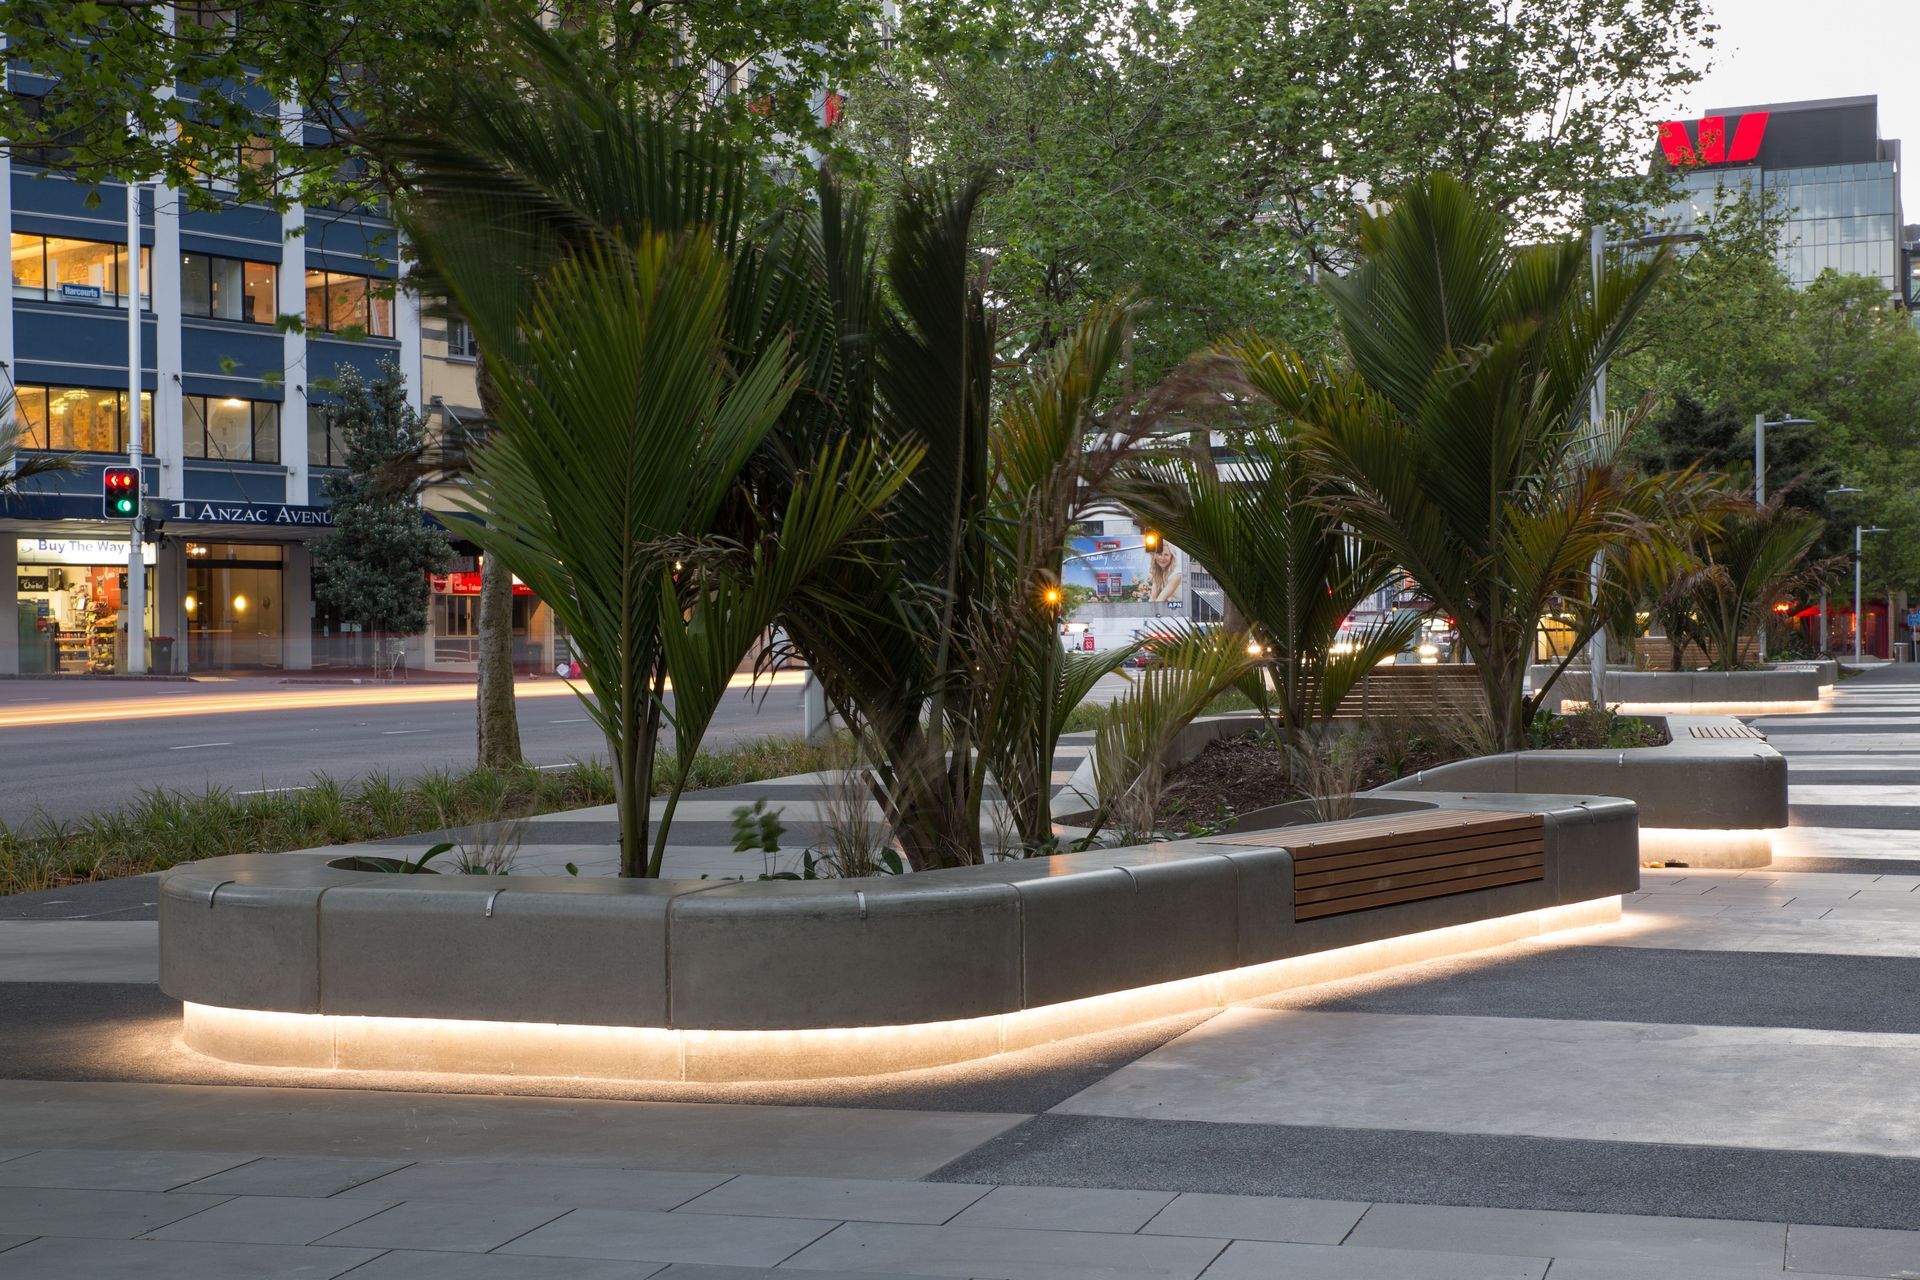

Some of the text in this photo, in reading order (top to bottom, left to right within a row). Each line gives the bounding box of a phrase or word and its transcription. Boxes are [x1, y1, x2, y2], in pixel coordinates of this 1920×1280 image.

[64, 286, 98, 298] Harcourts
[171, 502, 192, 520] 1
[276, 506, 333, 524] AVENU
[38, 539, 125, 554] Buy The Way
